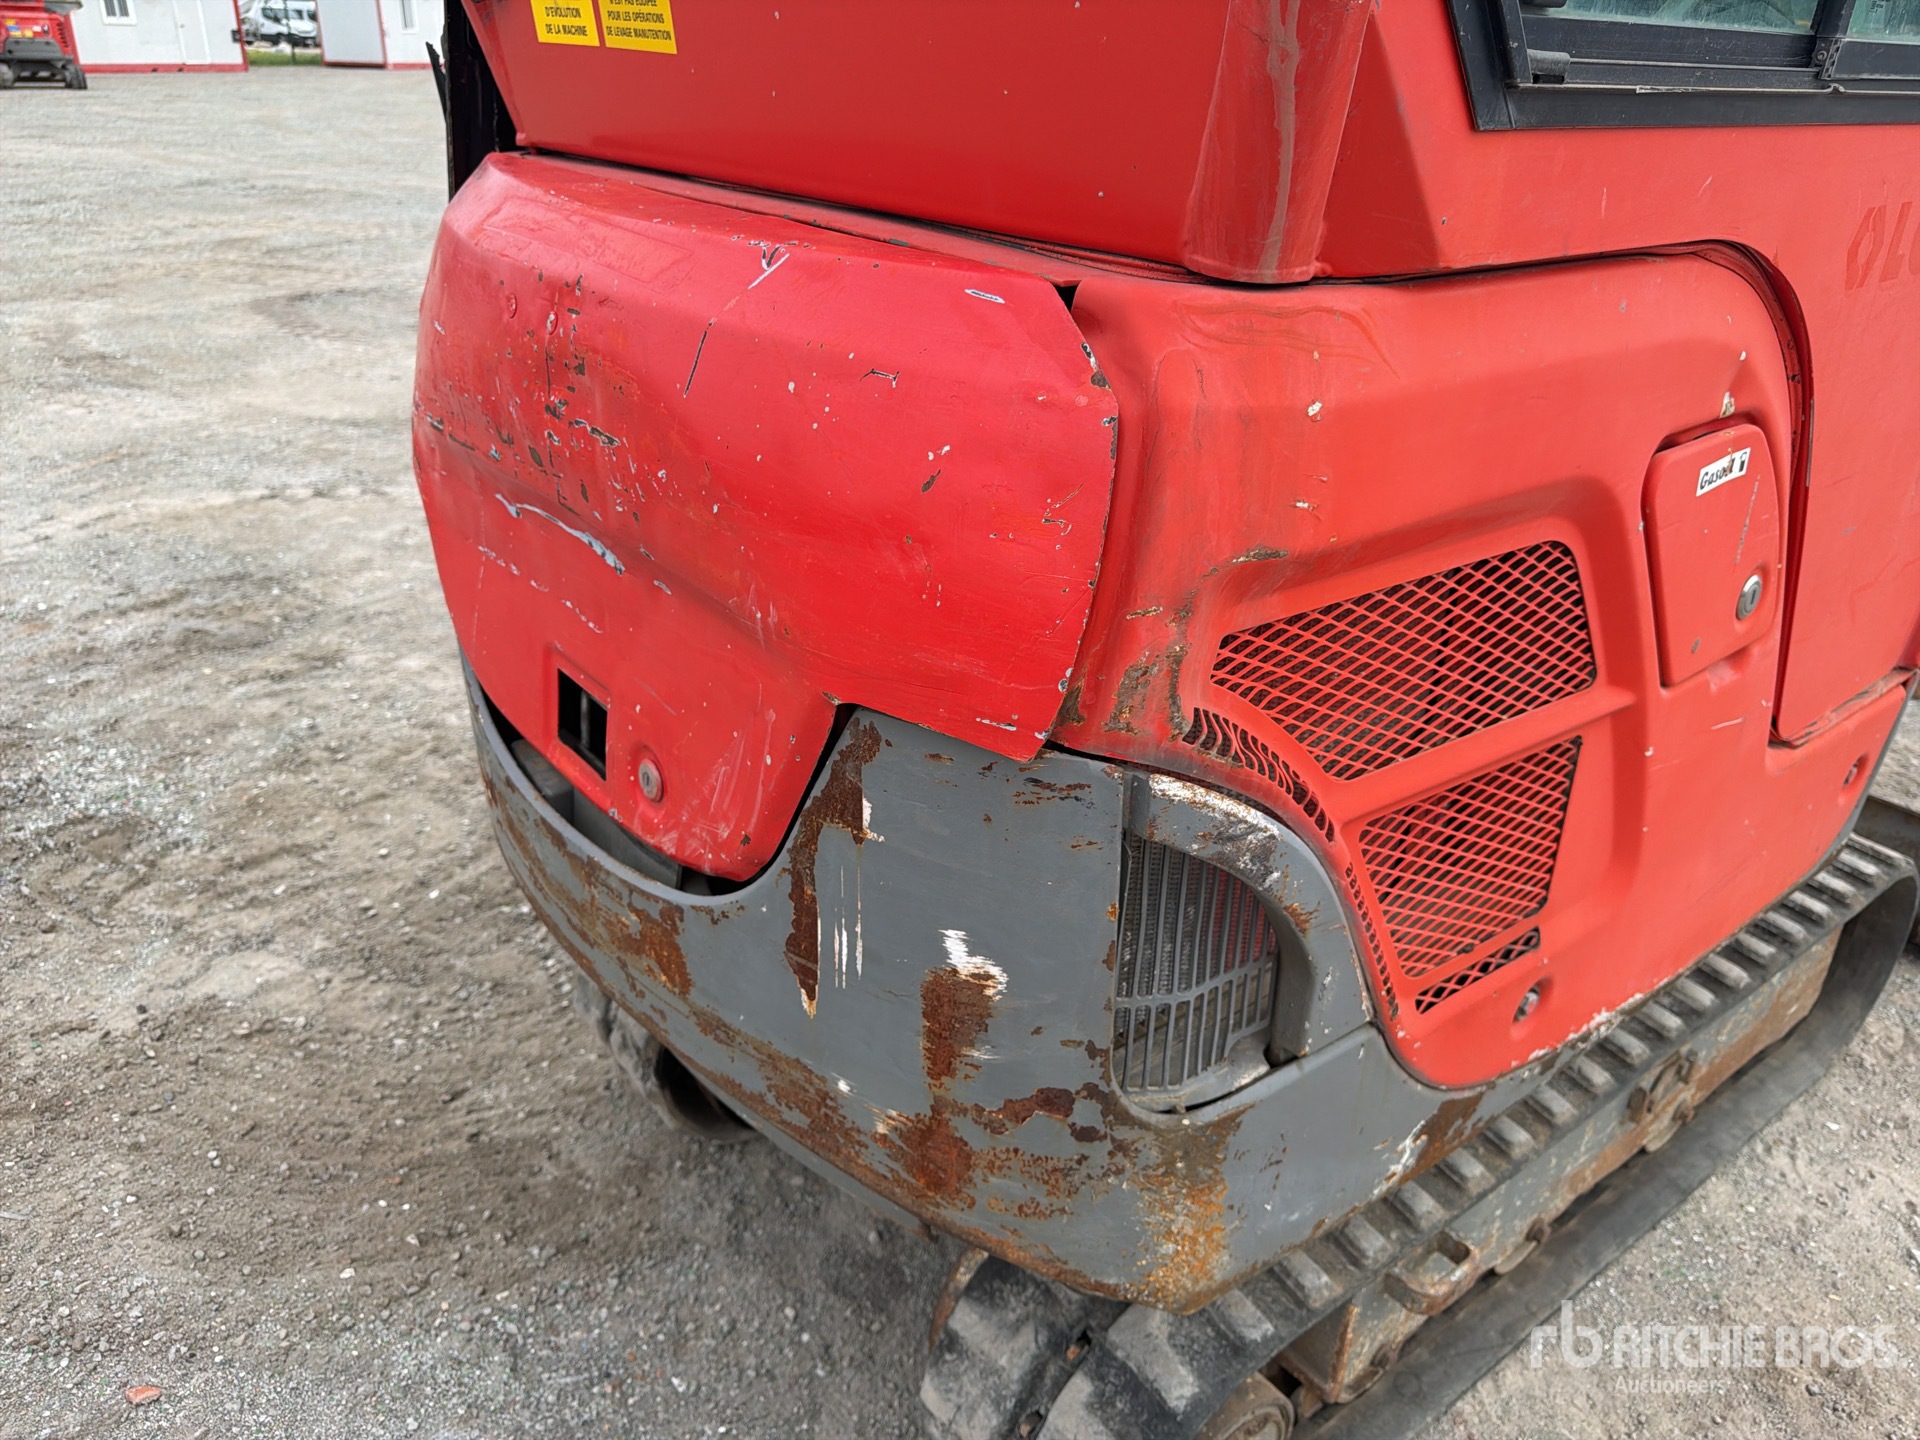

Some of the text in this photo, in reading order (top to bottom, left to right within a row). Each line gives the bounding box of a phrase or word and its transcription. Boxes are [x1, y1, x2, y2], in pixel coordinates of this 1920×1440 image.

[607, 10, 621, 21] POUR
[622, 11, 632, 22] LES
[545, 23, 588, 37] DE LA MACHINE
[606, 25, 672, 41] DE LEVAGE MANUTENTION
